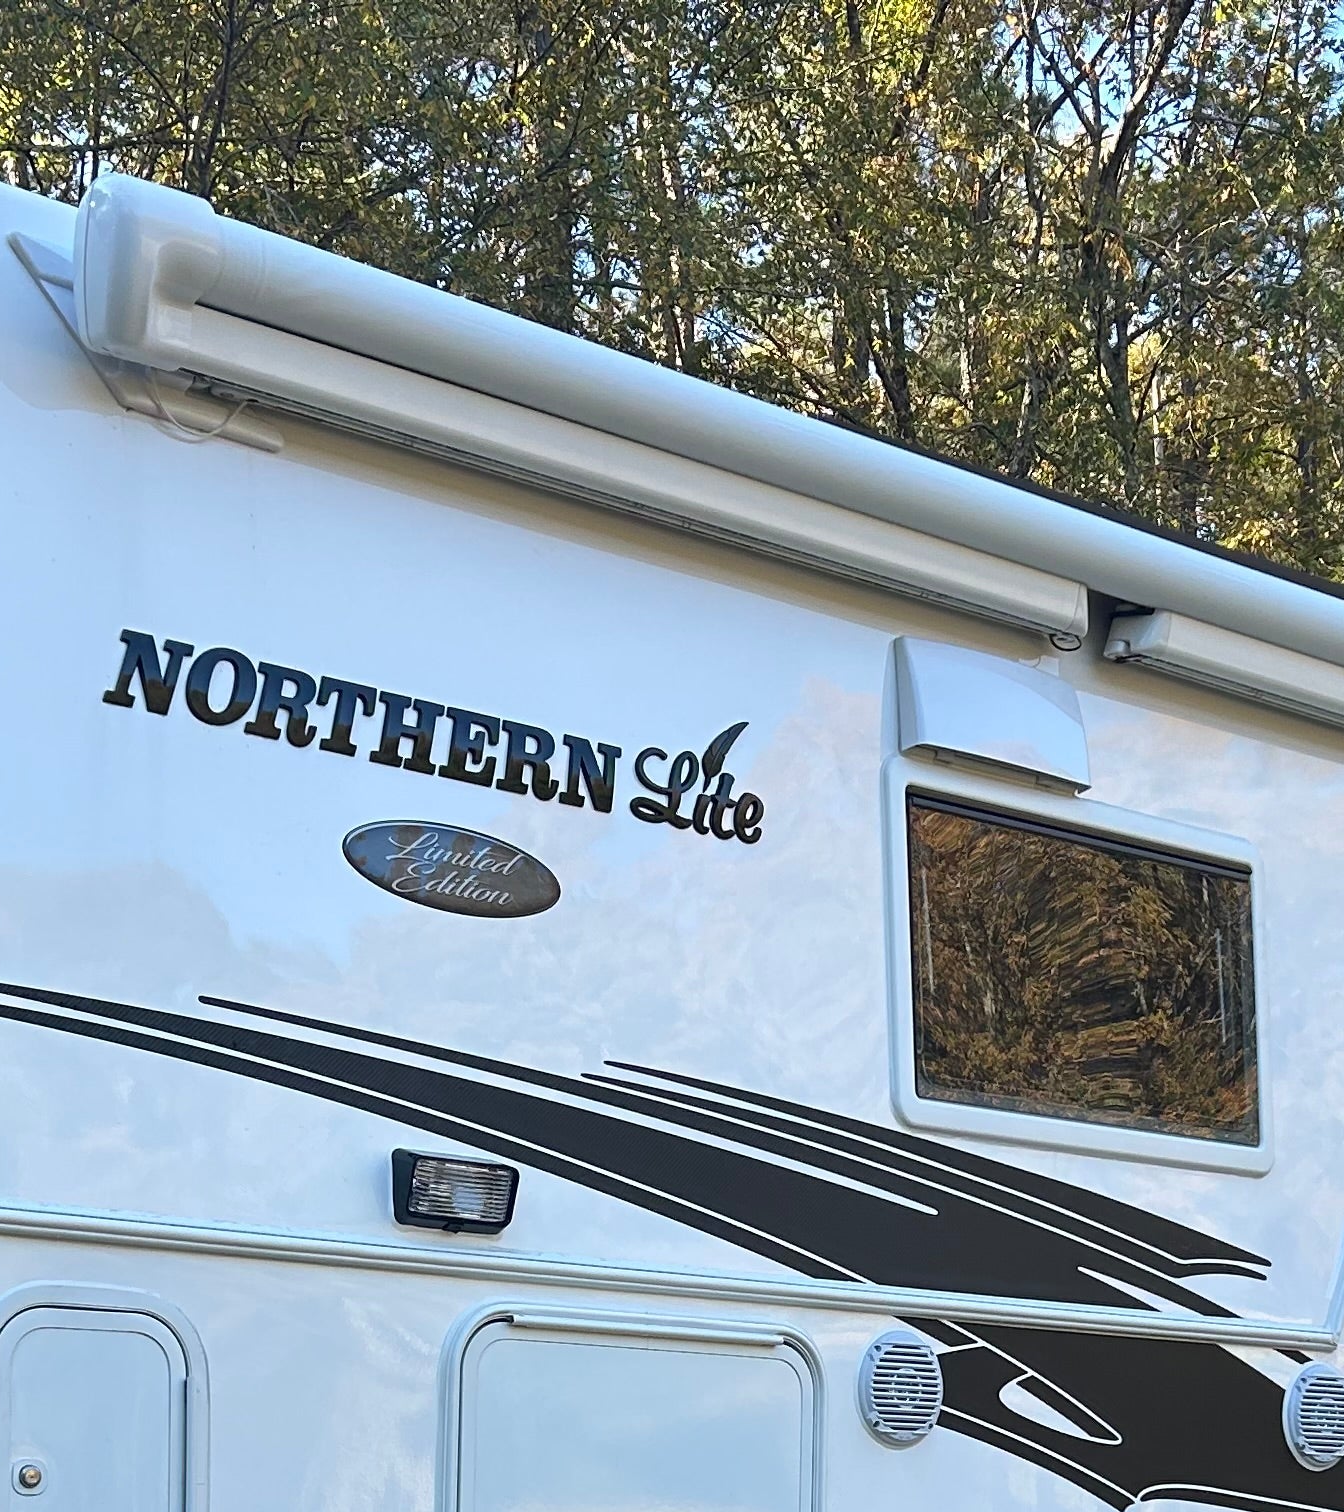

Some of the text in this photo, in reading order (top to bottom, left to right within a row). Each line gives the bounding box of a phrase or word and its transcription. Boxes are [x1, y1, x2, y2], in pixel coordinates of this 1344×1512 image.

[102, 628, 765, 845] NORTHERN Lite
[385, 831, 524, 877] Limited
[391, 861, 516, 906] Edition
